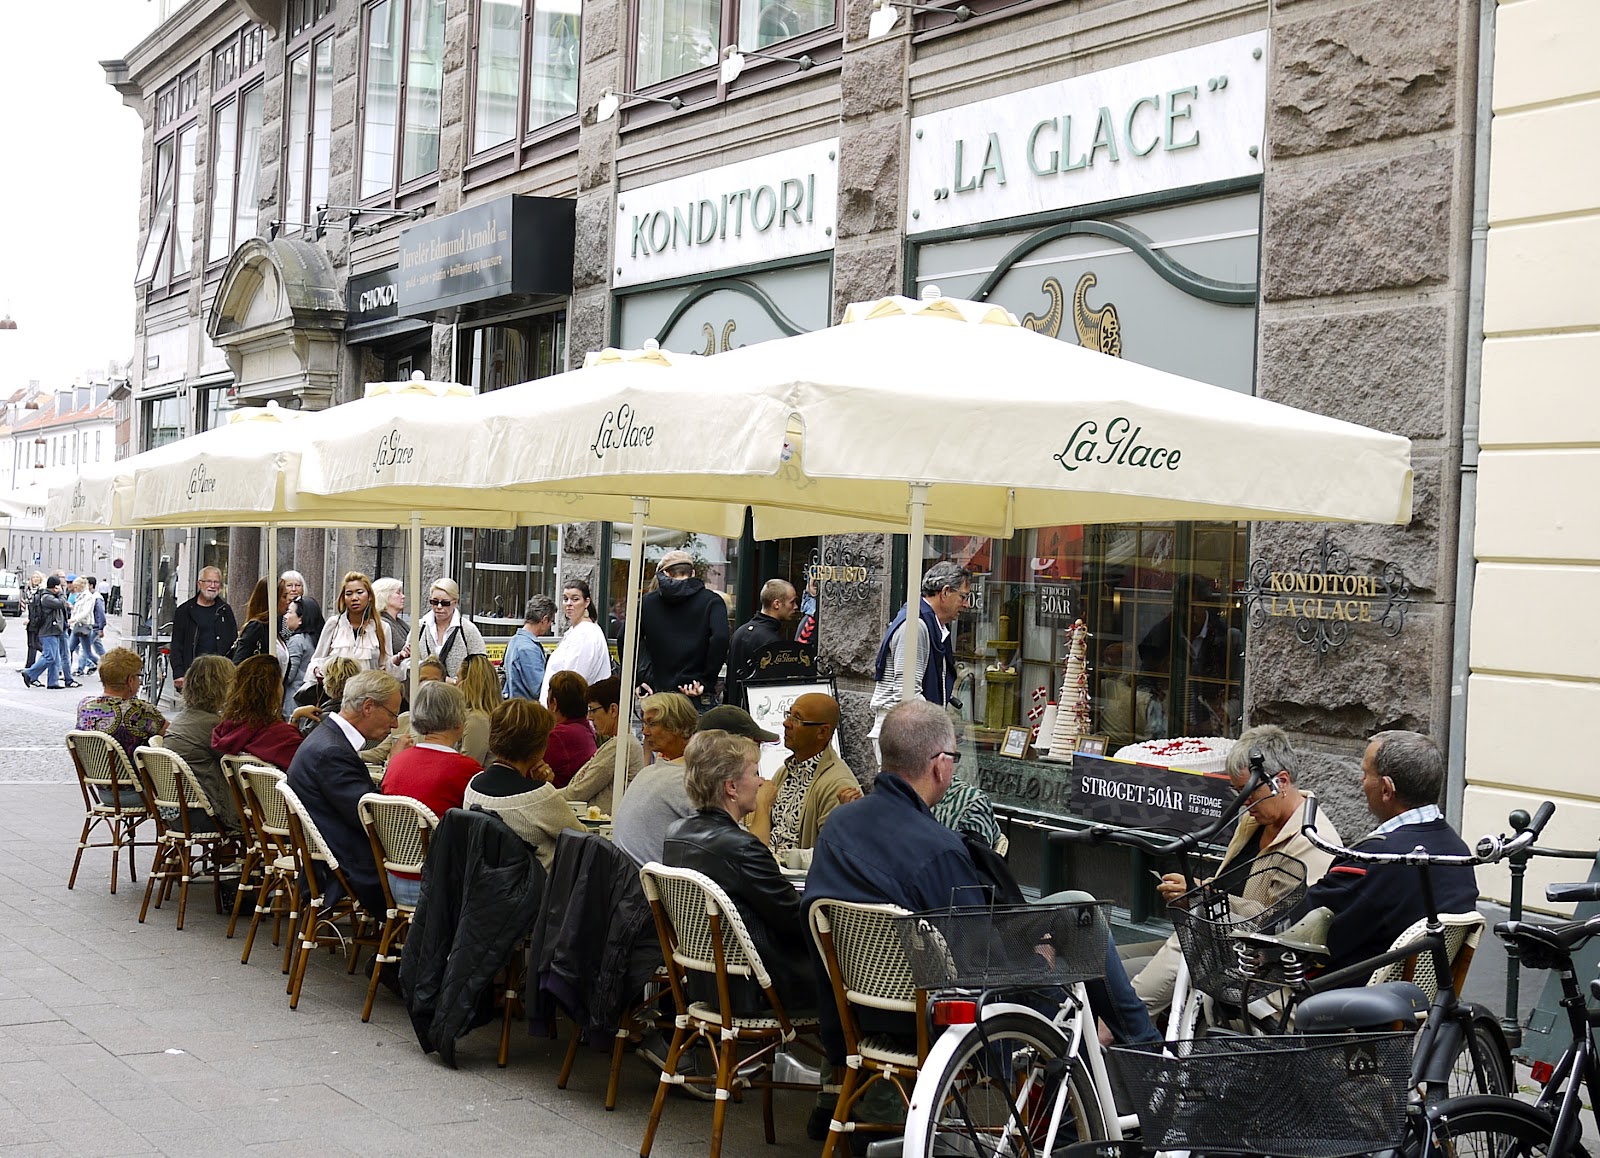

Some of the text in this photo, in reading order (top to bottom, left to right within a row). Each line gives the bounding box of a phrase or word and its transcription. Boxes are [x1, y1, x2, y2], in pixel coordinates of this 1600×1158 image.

[630, 173, 815, 258] KONDITORI
[431, 228, 464, 261] Edmund
[465, 219, 497, 252] Arnold
[612, 403, 655, 449] Glace
[1053, 416, 1182, 472] La Glace
[842, 566, 868, 582] 1870
[1270, 571, 1378, 597] KONDITORI
[1041, 595, 1072, 615] 50ÅR
[1271, 596, 1373, 622] LA GLACE
[1081, 775, 1184, 811] STRØGET 50ÅR
[1188, 793, 1223, 809] FESTDAGE
